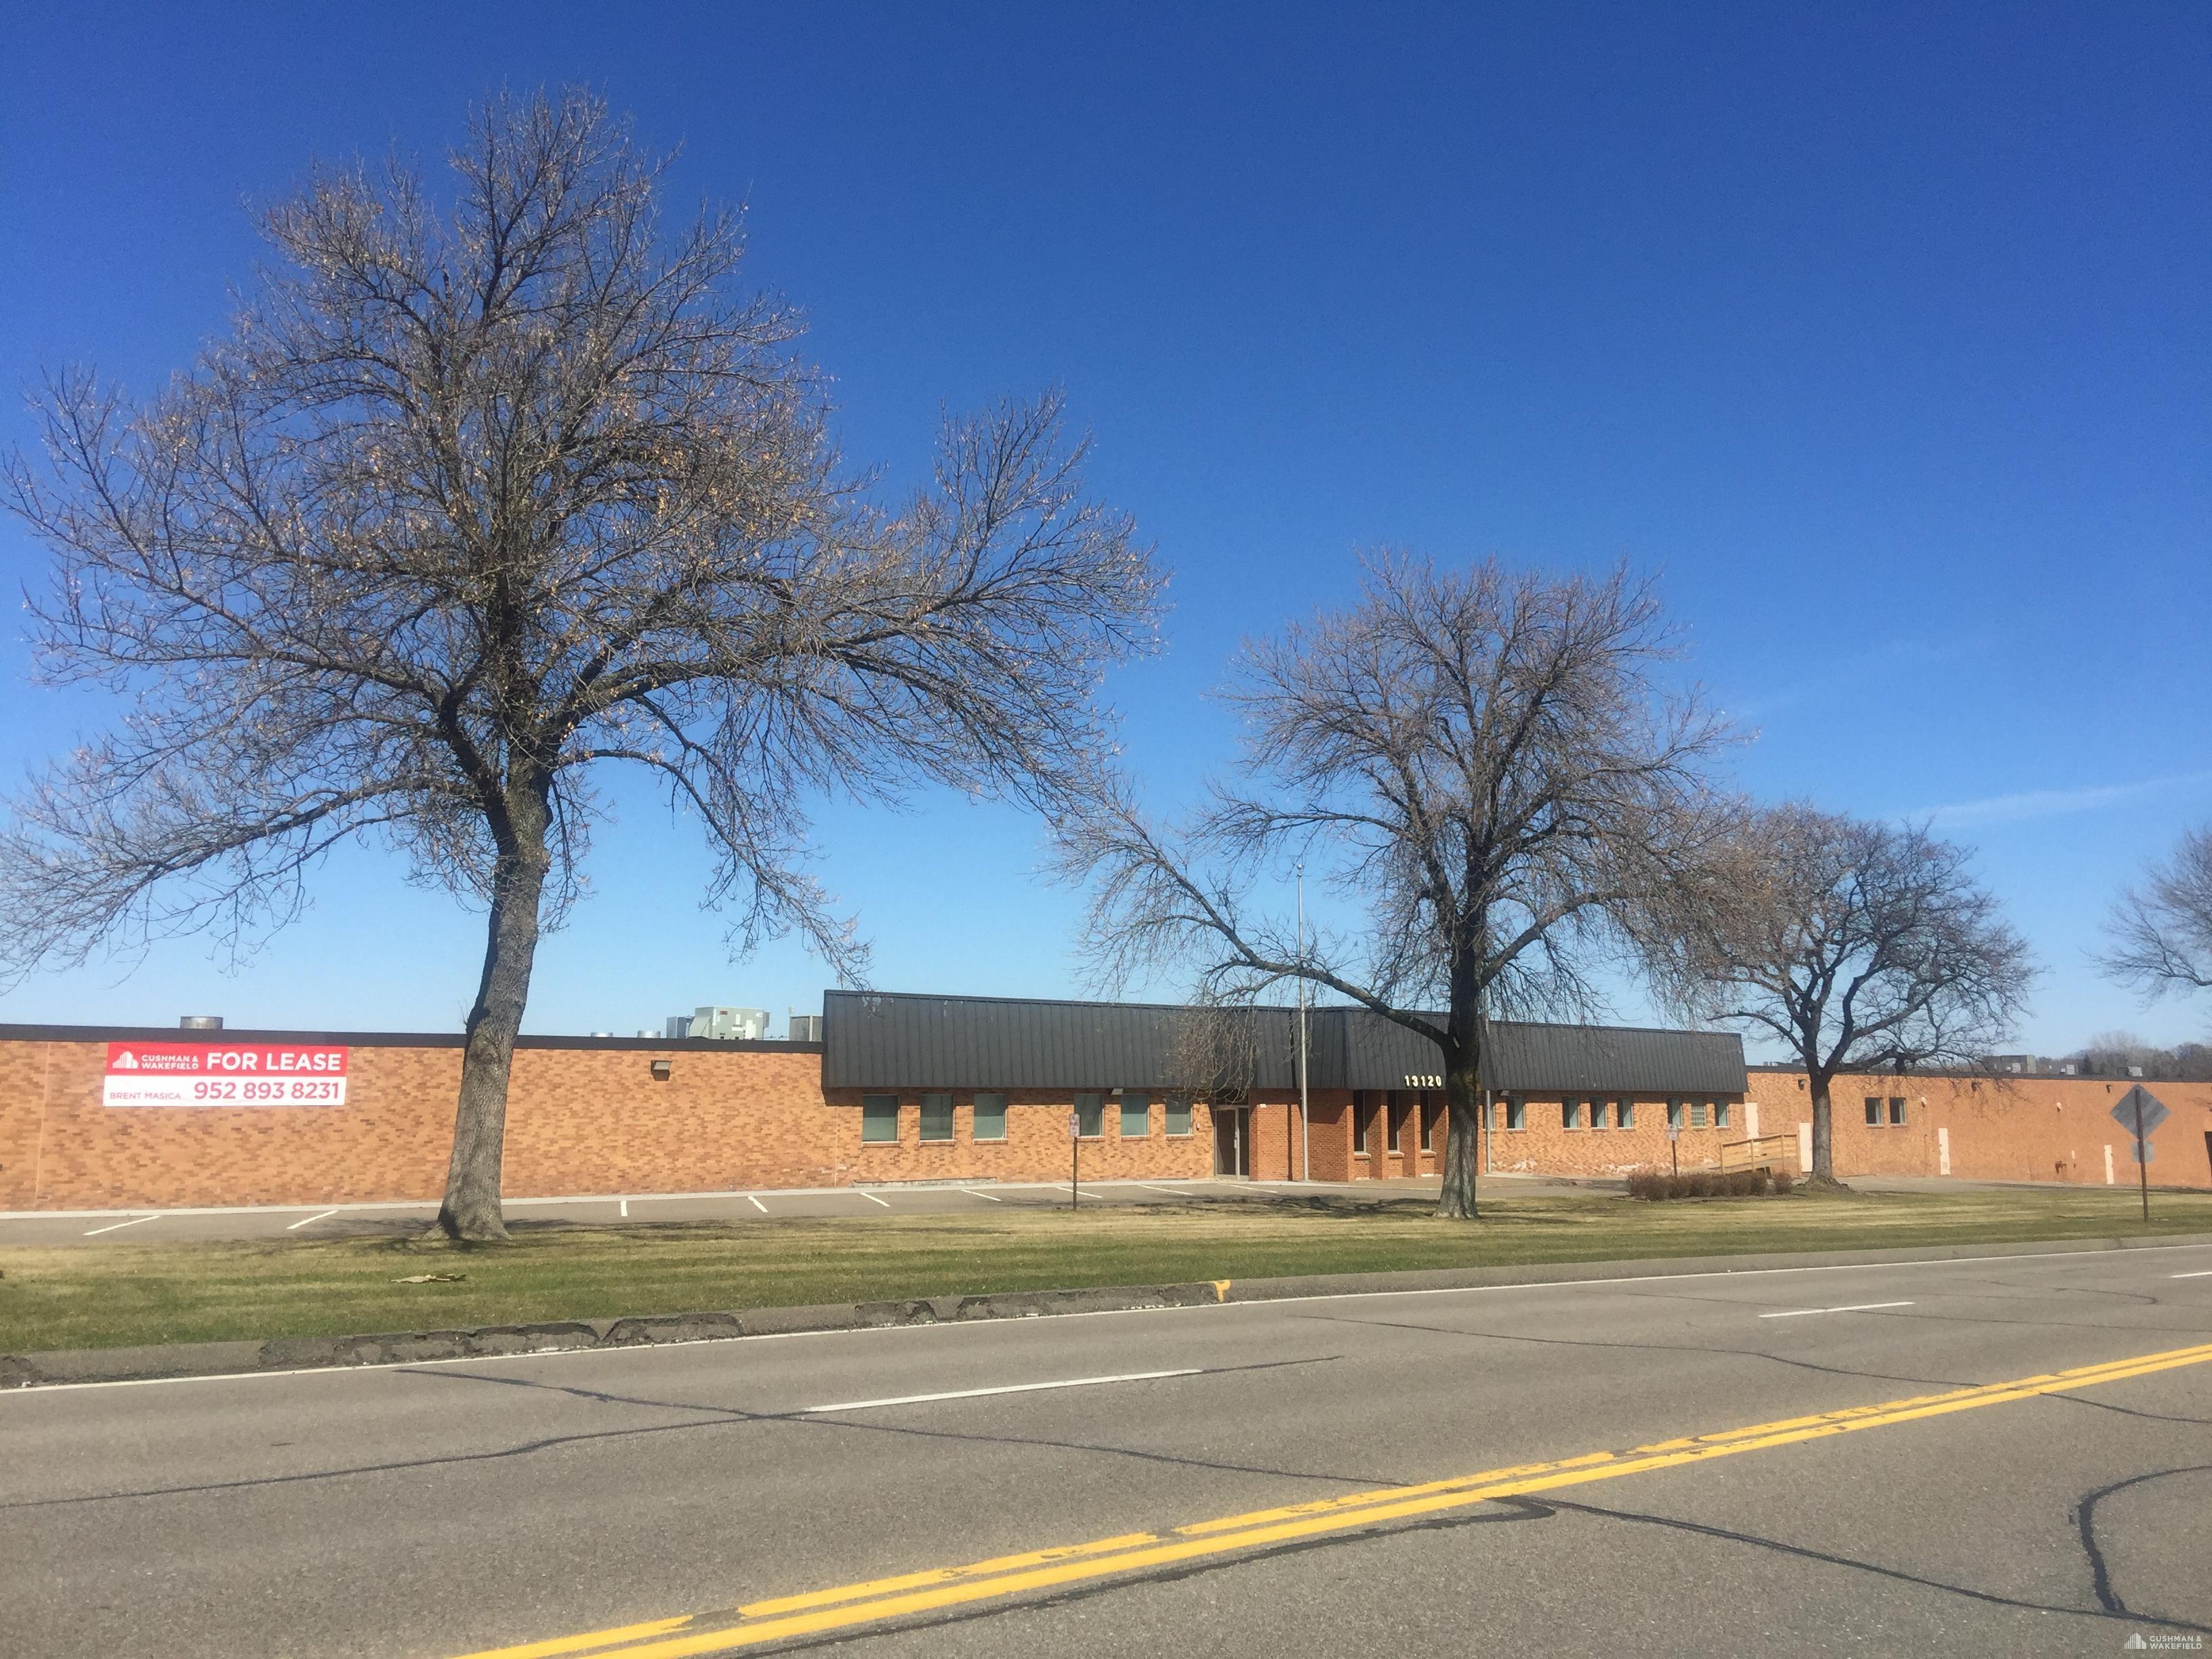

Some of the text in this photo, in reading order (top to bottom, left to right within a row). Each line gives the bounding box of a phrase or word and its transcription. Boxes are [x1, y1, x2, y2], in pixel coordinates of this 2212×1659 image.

[207, 1052, 342, 1071] FOR LEASE
[1405, 1075, 1441, 1086] 13120
[110, 1092, 141, 1100] BRENT
[194, 1082, 339, 1099] 952 893 8231
